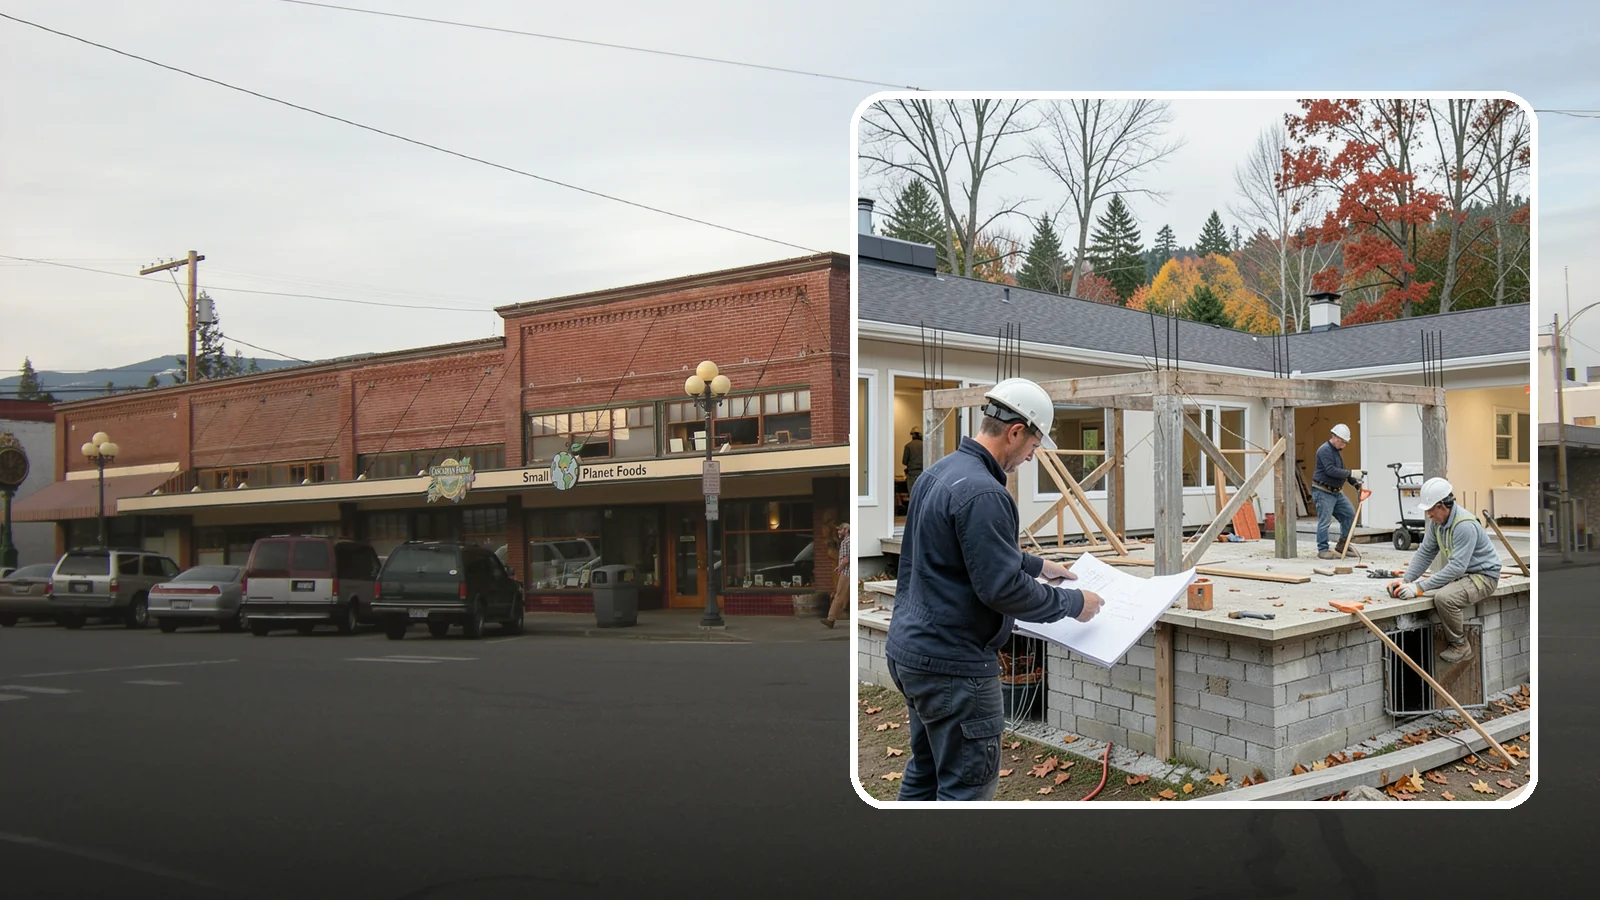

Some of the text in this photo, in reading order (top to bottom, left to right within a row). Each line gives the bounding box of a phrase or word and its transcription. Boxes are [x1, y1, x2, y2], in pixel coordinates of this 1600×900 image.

[523, 464, 647, 483] Small Planet Foods
